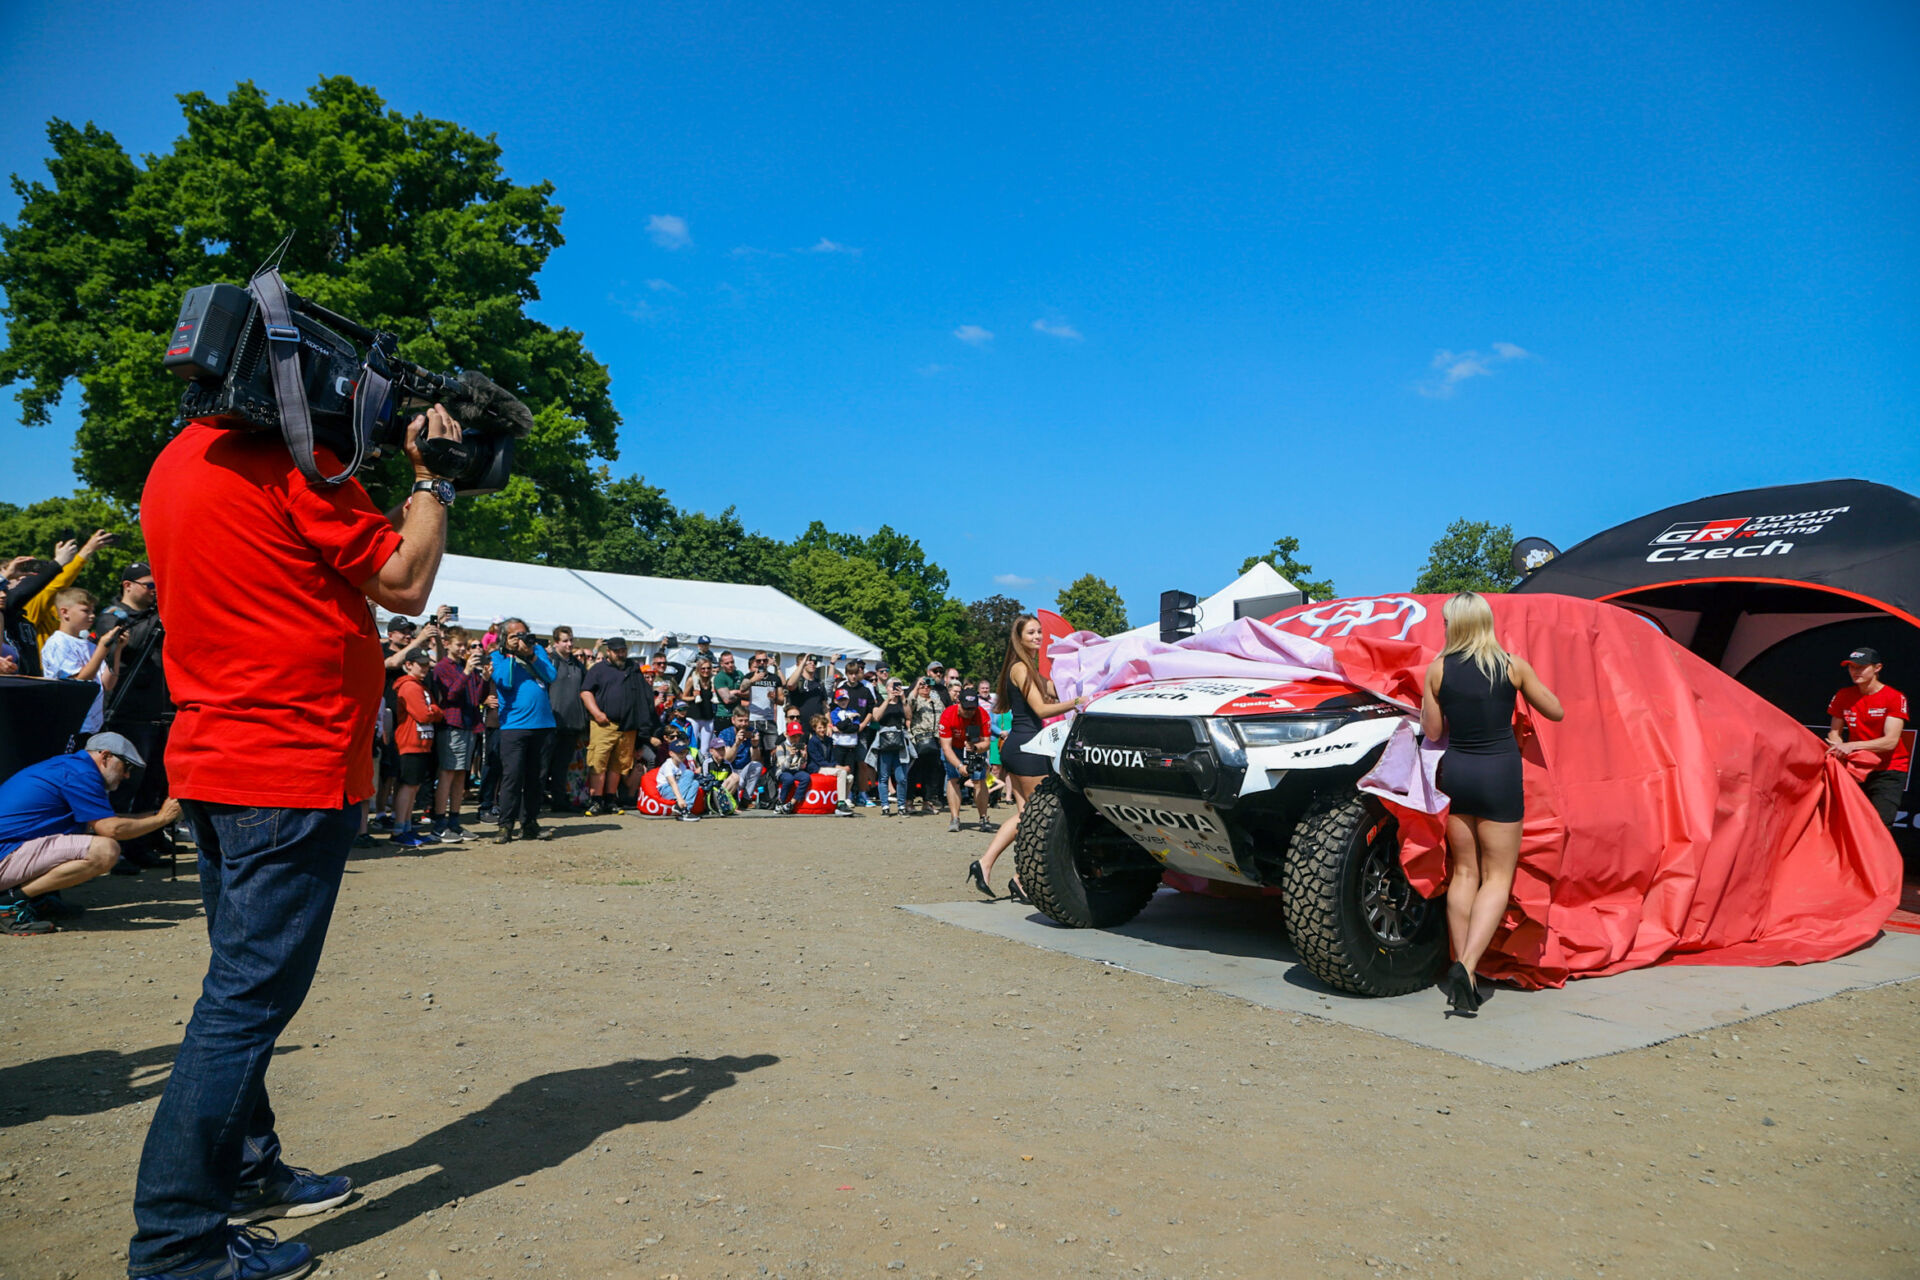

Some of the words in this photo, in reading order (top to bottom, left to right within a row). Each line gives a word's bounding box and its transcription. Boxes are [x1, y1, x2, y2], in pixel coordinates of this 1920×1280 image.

[1743, 515, 1834, 532] GAZOO
[1755, 505, 1851, 524] TOYOTA
[1655, 526, 1736, 544] GR
[1735, 524, 1824, 539] Racing
[1646, 539, 1794, 563] Czech
[1116, 692, 1189, 701] Czech
[1083, 746, 1145, 768] TOYOTA
[1290, 741, 1360, 759] XTLINE
[1102, 803, 1219, 834] TOYOTA
[1132, 832, 1167, 846] over
[1184, 838, 1232, 856] drive
